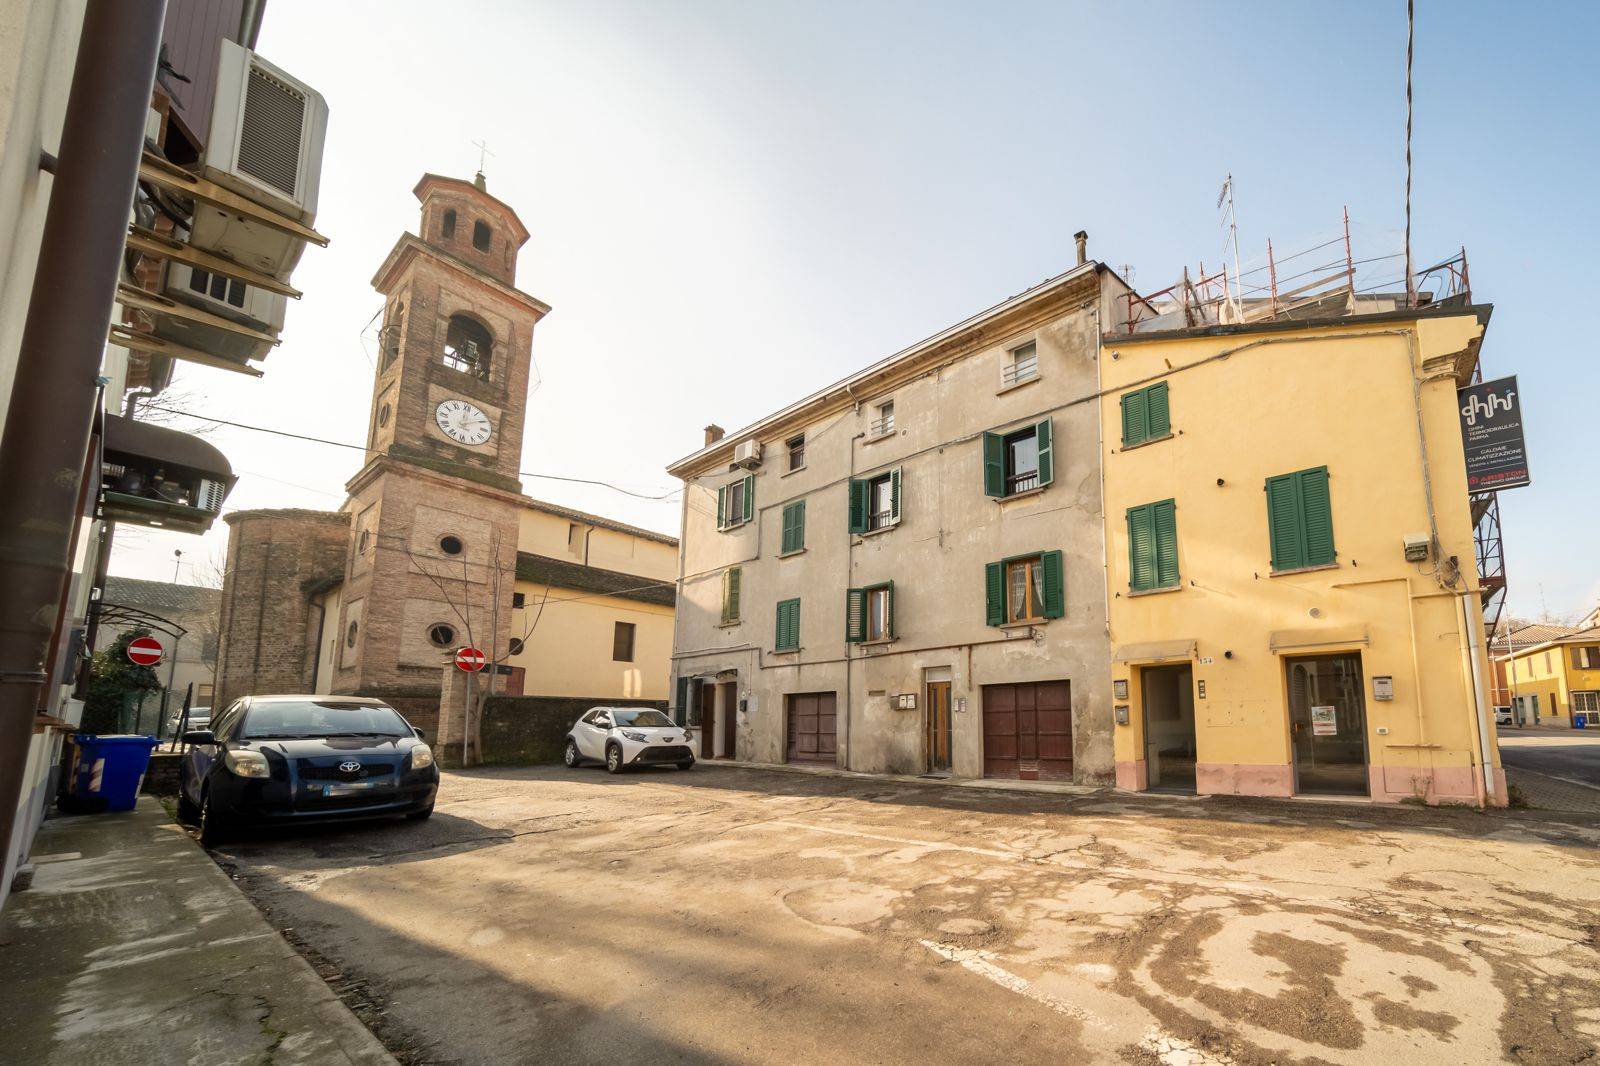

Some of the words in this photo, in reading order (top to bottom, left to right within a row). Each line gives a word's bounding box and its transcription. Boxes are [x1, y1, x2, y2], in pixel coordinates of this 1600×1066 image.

[1469, 422, 1520, 436] TERMOIDRAULICA
[1468, 448, 1522, 463] CLIMATIZZAZIONE
[1480, 445, 1507, 454] CALDAIE
[1480, 469, 1527, 482] ARISTON
[1480, 478, 1504, 486] THERMO
